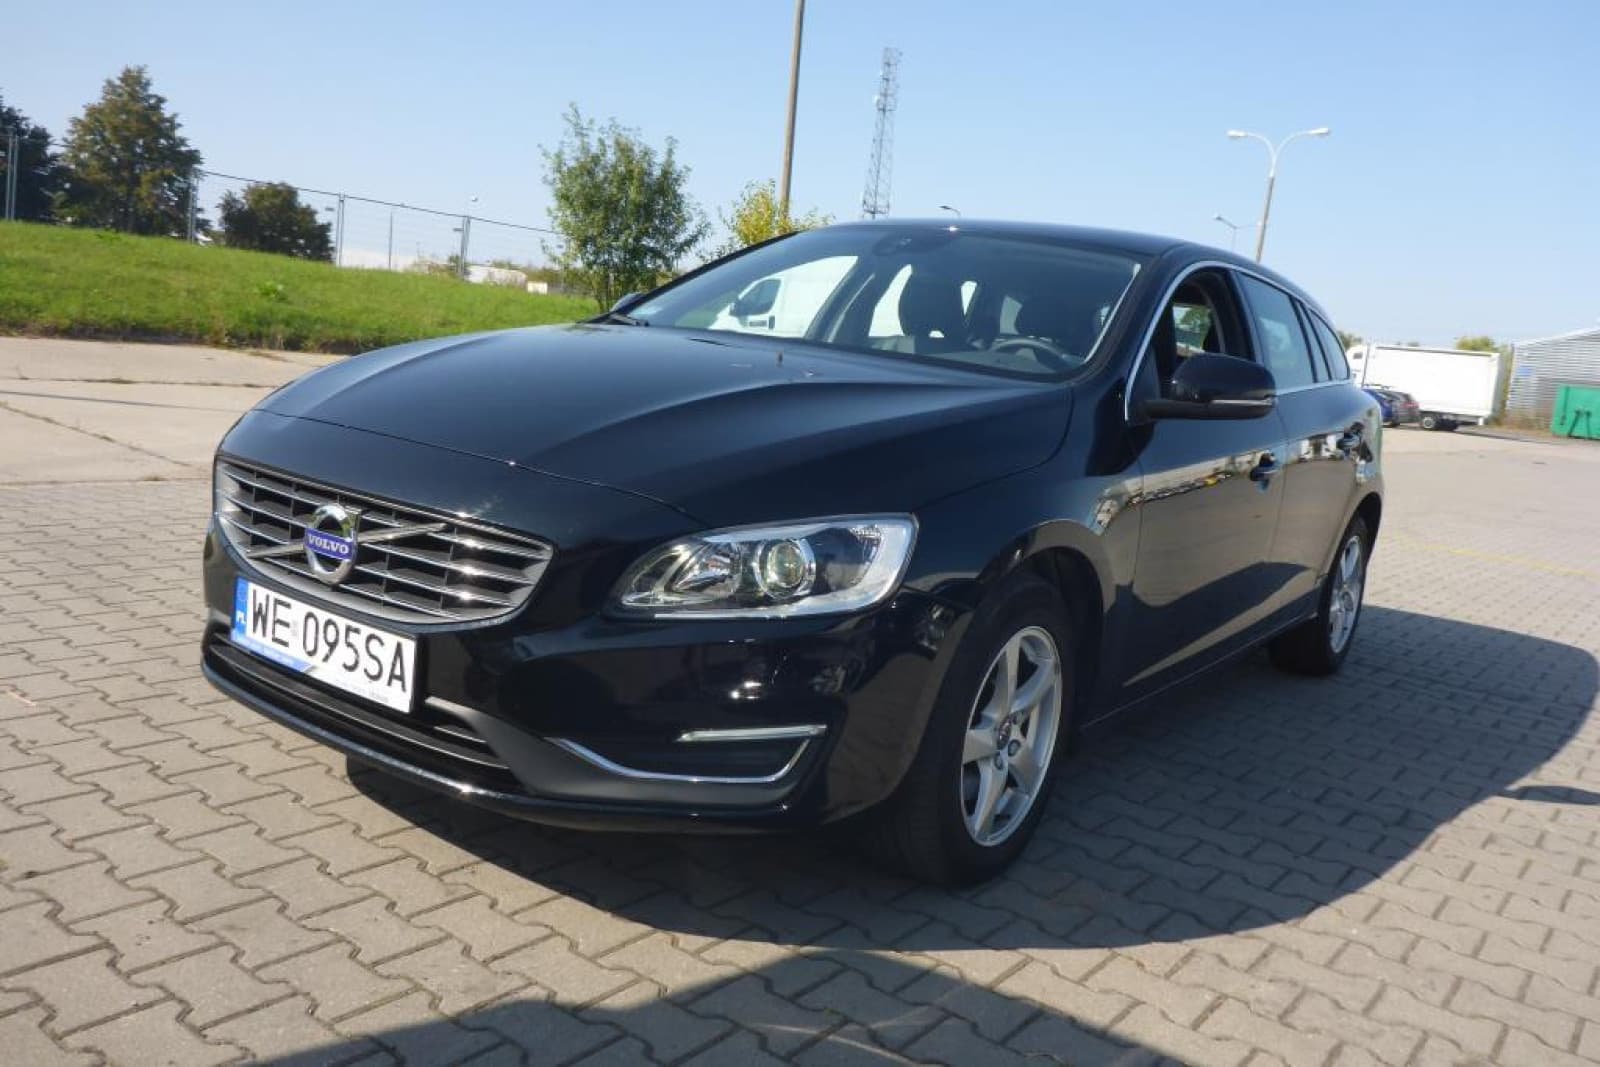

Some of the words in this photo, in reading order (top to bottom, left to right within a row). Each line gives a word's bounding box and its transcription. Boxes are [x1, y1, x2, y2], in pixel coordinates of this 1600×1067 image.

[307, 533, 350, 554] VOLVO
[252, 589, 292, 648] WE
[303, 611, 407, 693] 095SA
